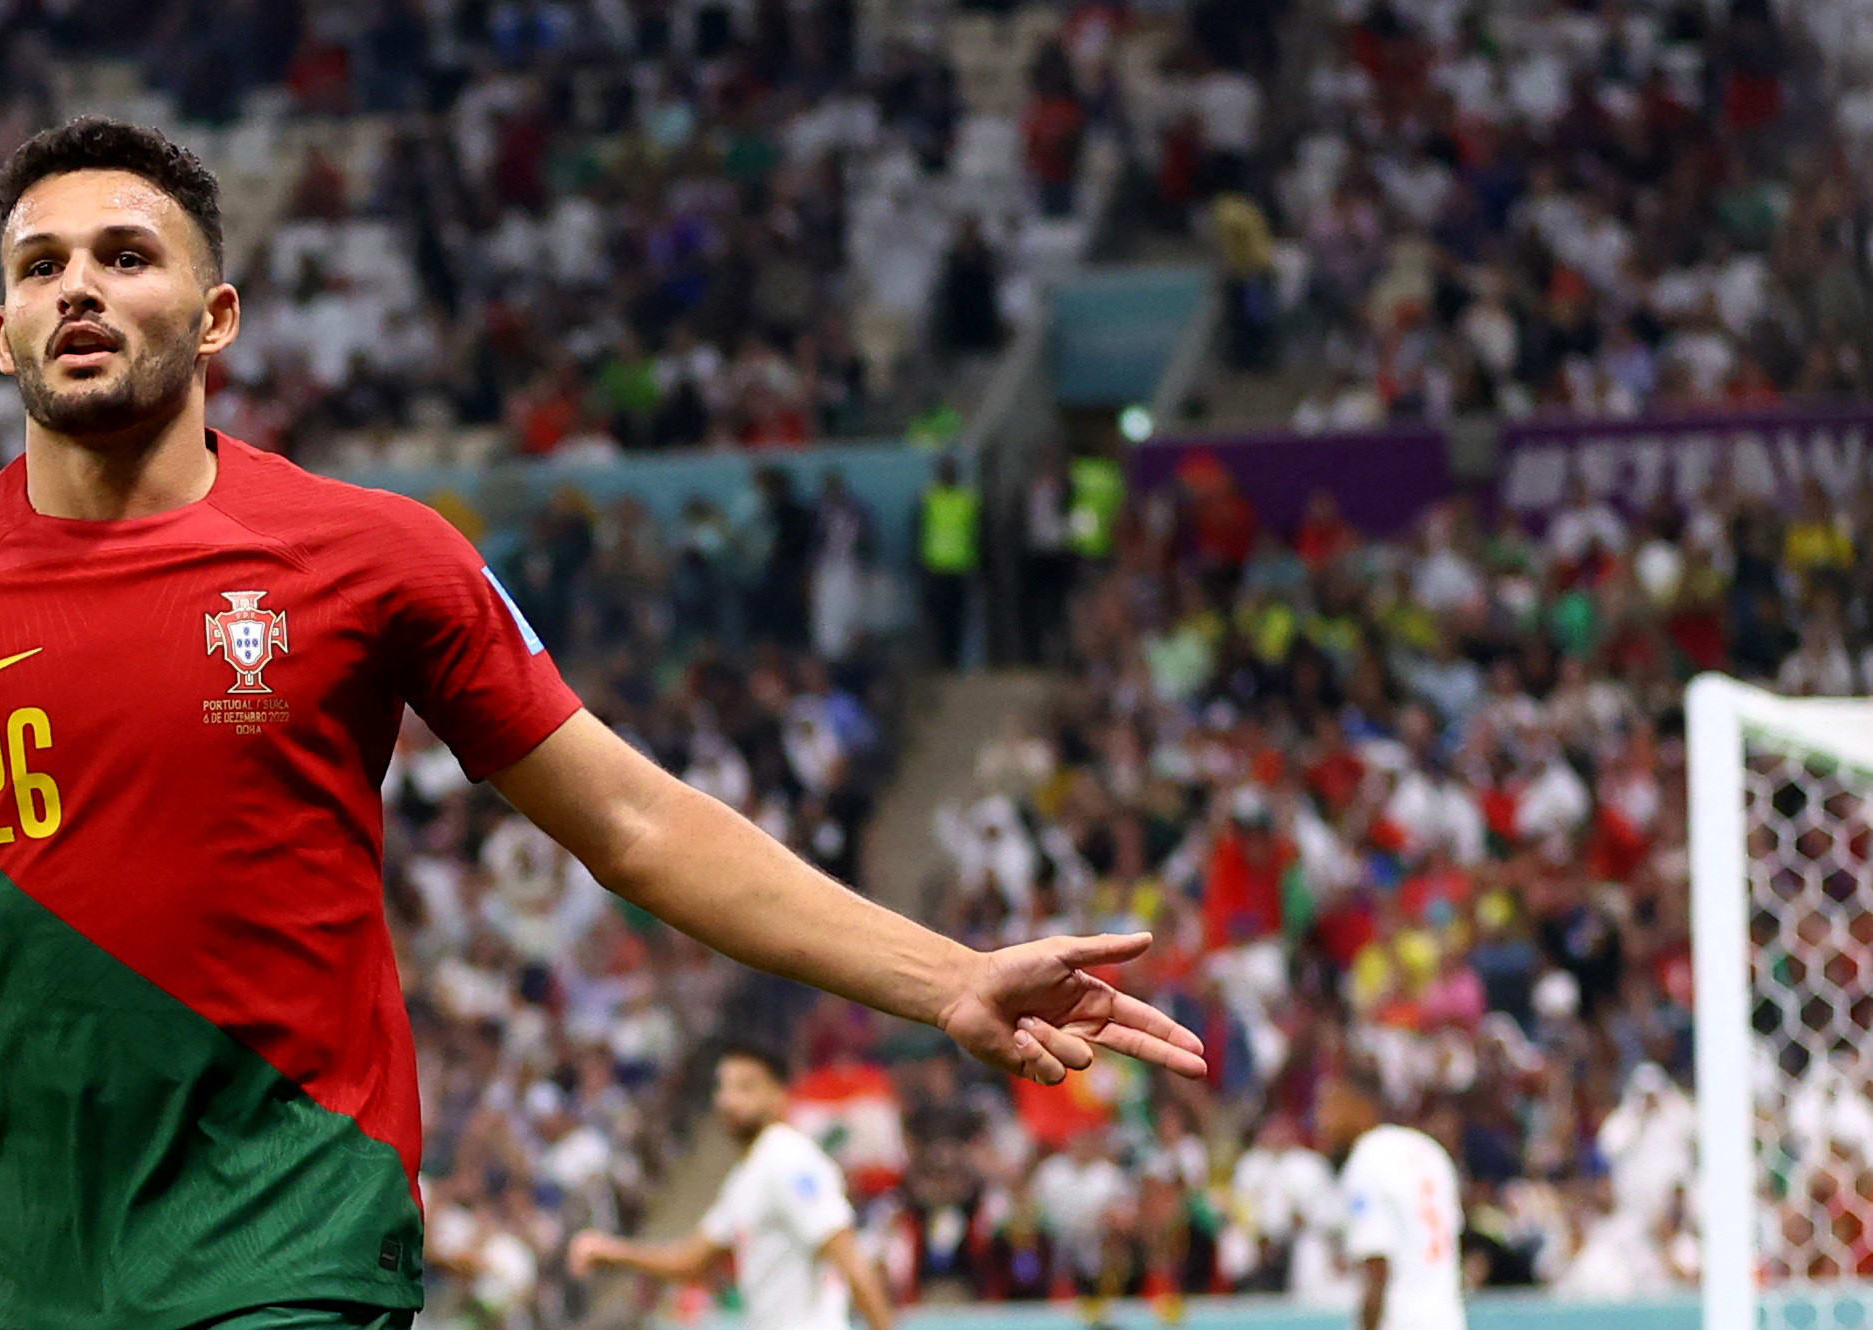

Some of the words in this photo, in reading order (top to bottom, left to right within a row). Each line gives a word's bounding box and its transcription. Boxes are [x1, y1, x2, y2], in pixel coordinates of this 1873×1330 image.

[203, 699, 252, 711] PORTUGAL
[203, 713, 209, 724] 6
[211, 712, 222, 724] DE
[223, 711, 267, 723] DEZEMBRO
